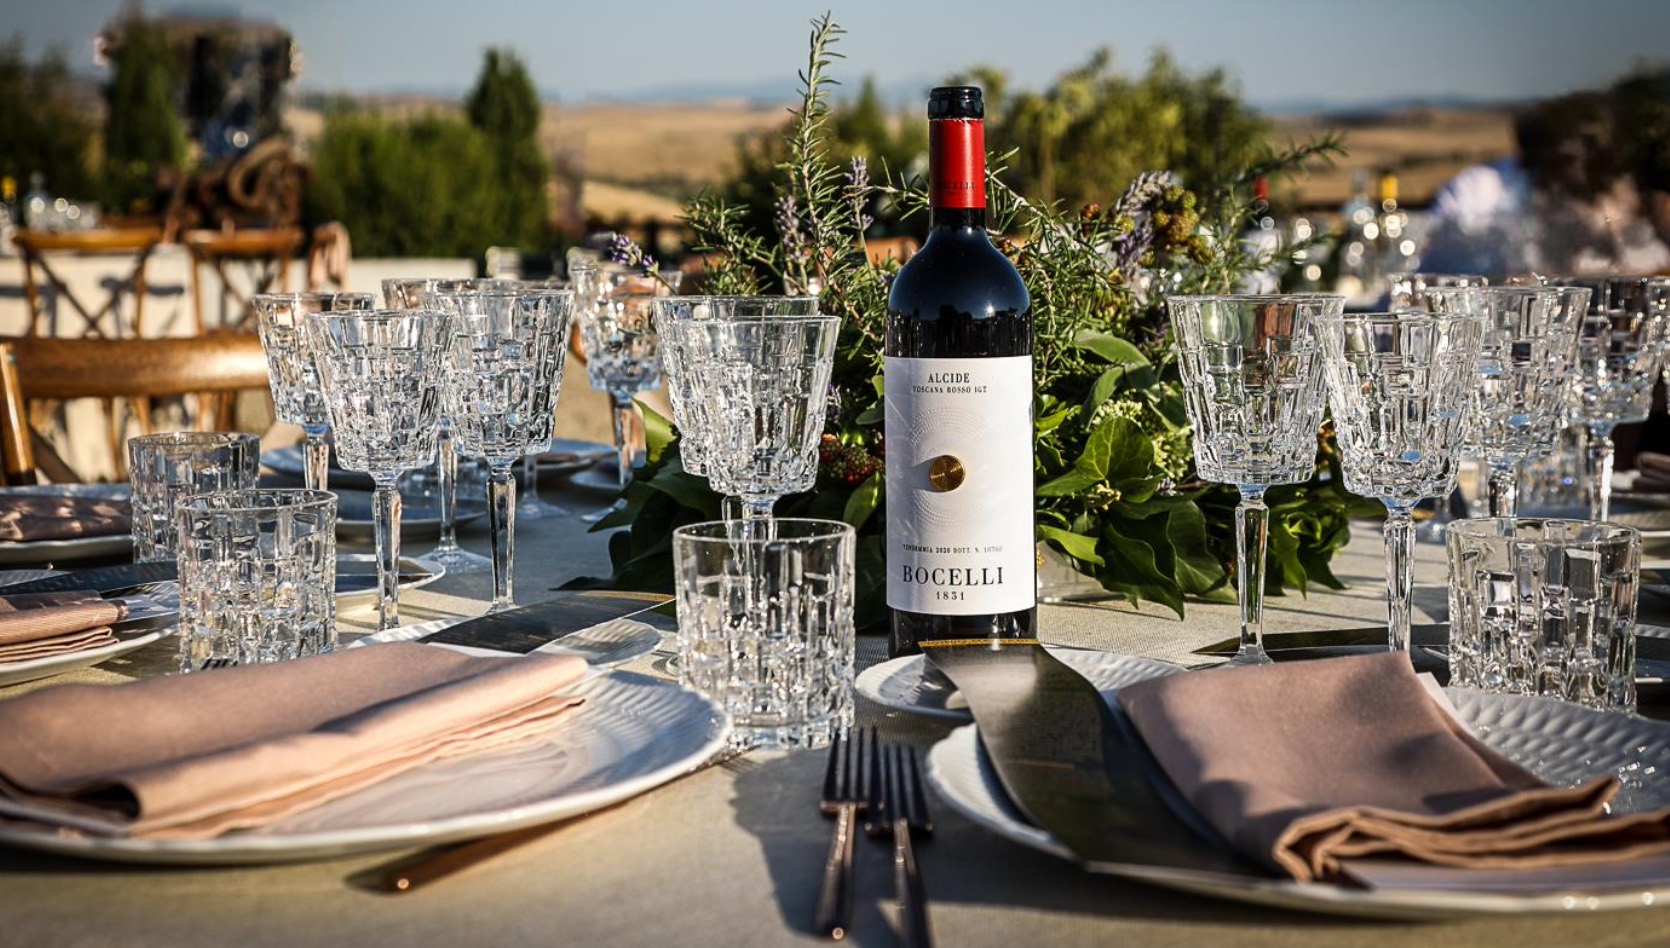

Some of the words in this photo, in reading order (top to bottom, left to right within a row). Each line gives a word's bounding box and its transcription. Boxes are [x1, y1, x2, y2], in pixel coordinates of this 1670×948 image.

[928, 372, 970, 384] ALCIDE
[912, 385, 943, 394] TOSCANA
[947, 385, 971, 394] ROSSO
[974, 385, 987, 393] IGT
[903, 565, 1003, 586] BOCELLI
[936, 591, 964, 601] 1831
